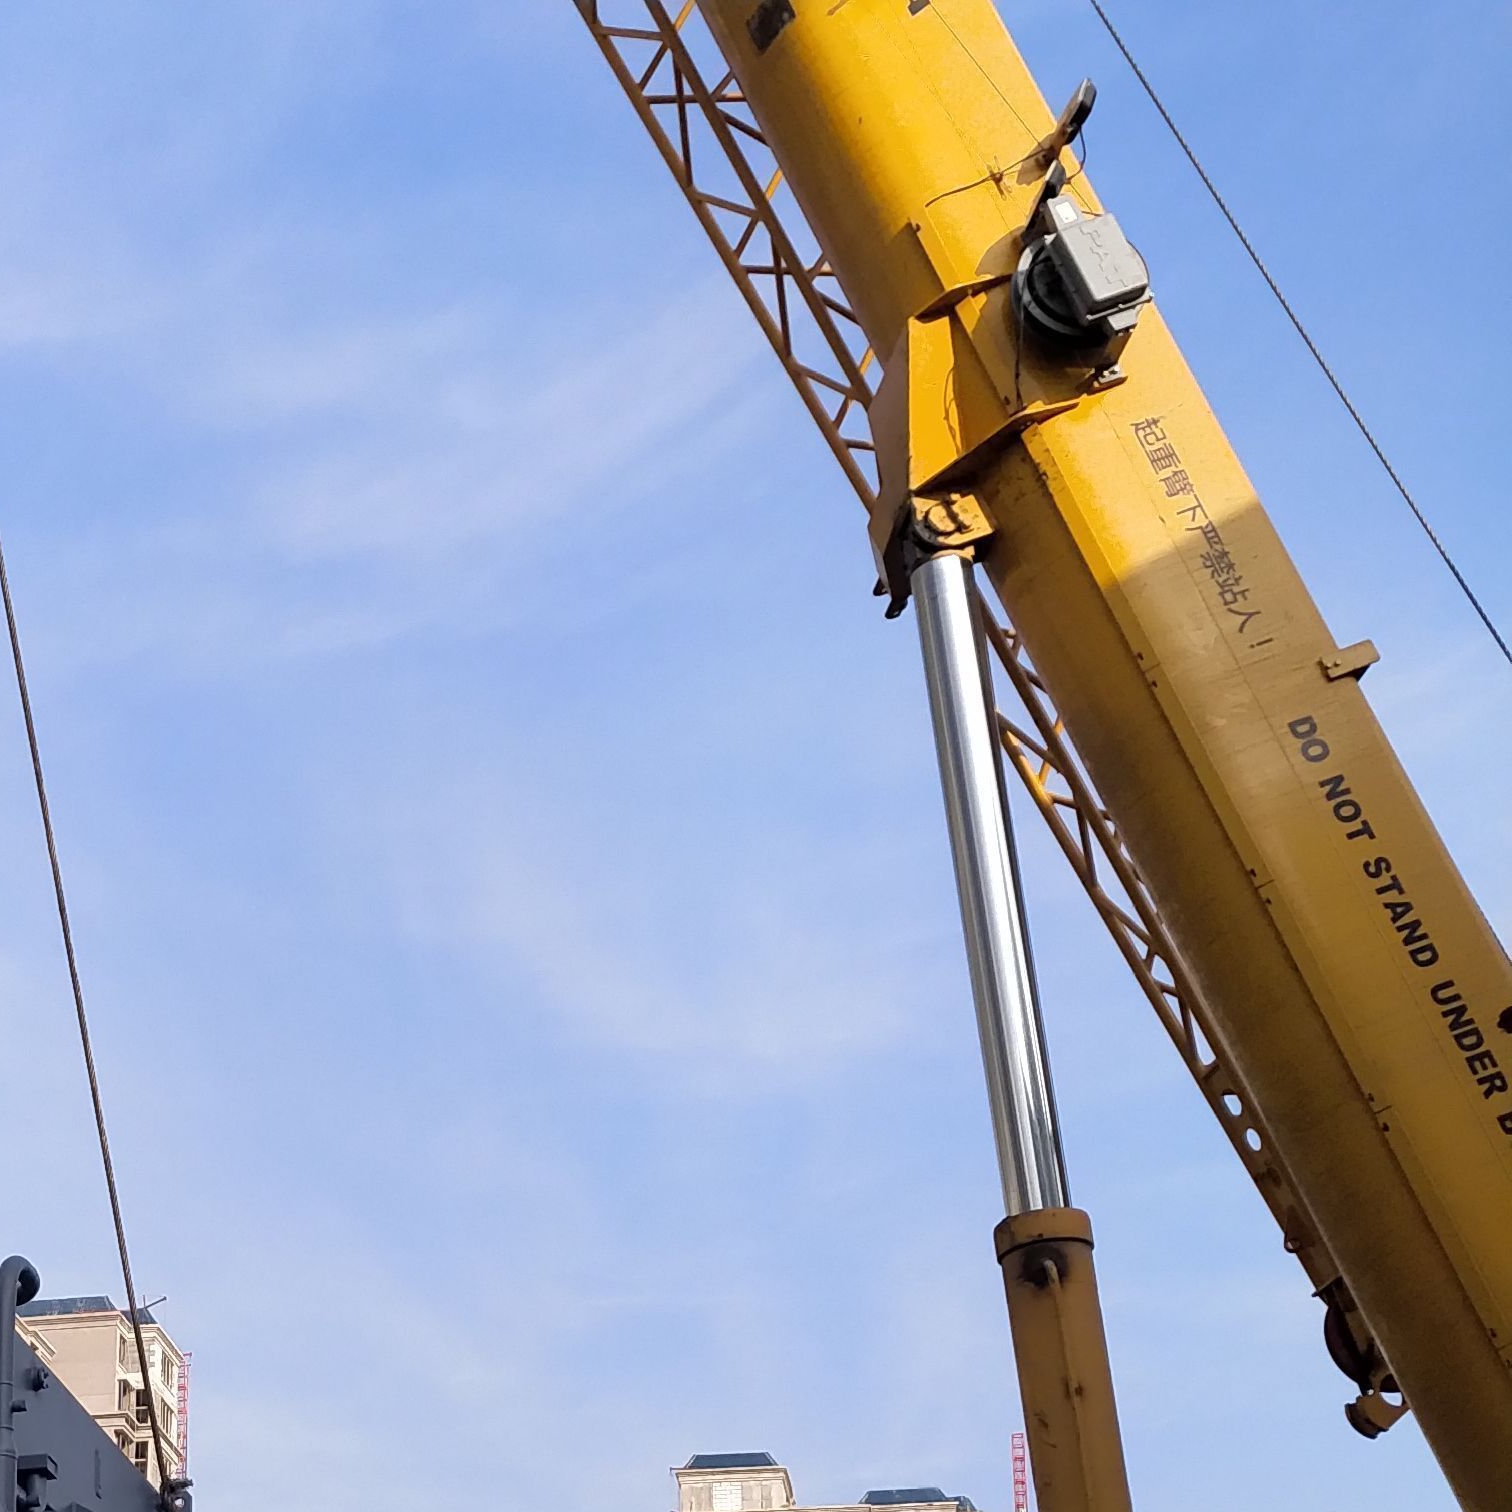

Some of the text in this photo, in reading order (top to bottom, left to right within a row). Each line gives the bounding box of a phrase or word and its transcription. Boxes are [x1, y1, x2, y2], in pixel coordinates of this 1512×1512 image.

[1287, 714, 1509, 1101] DO NOT STAND UNDER
